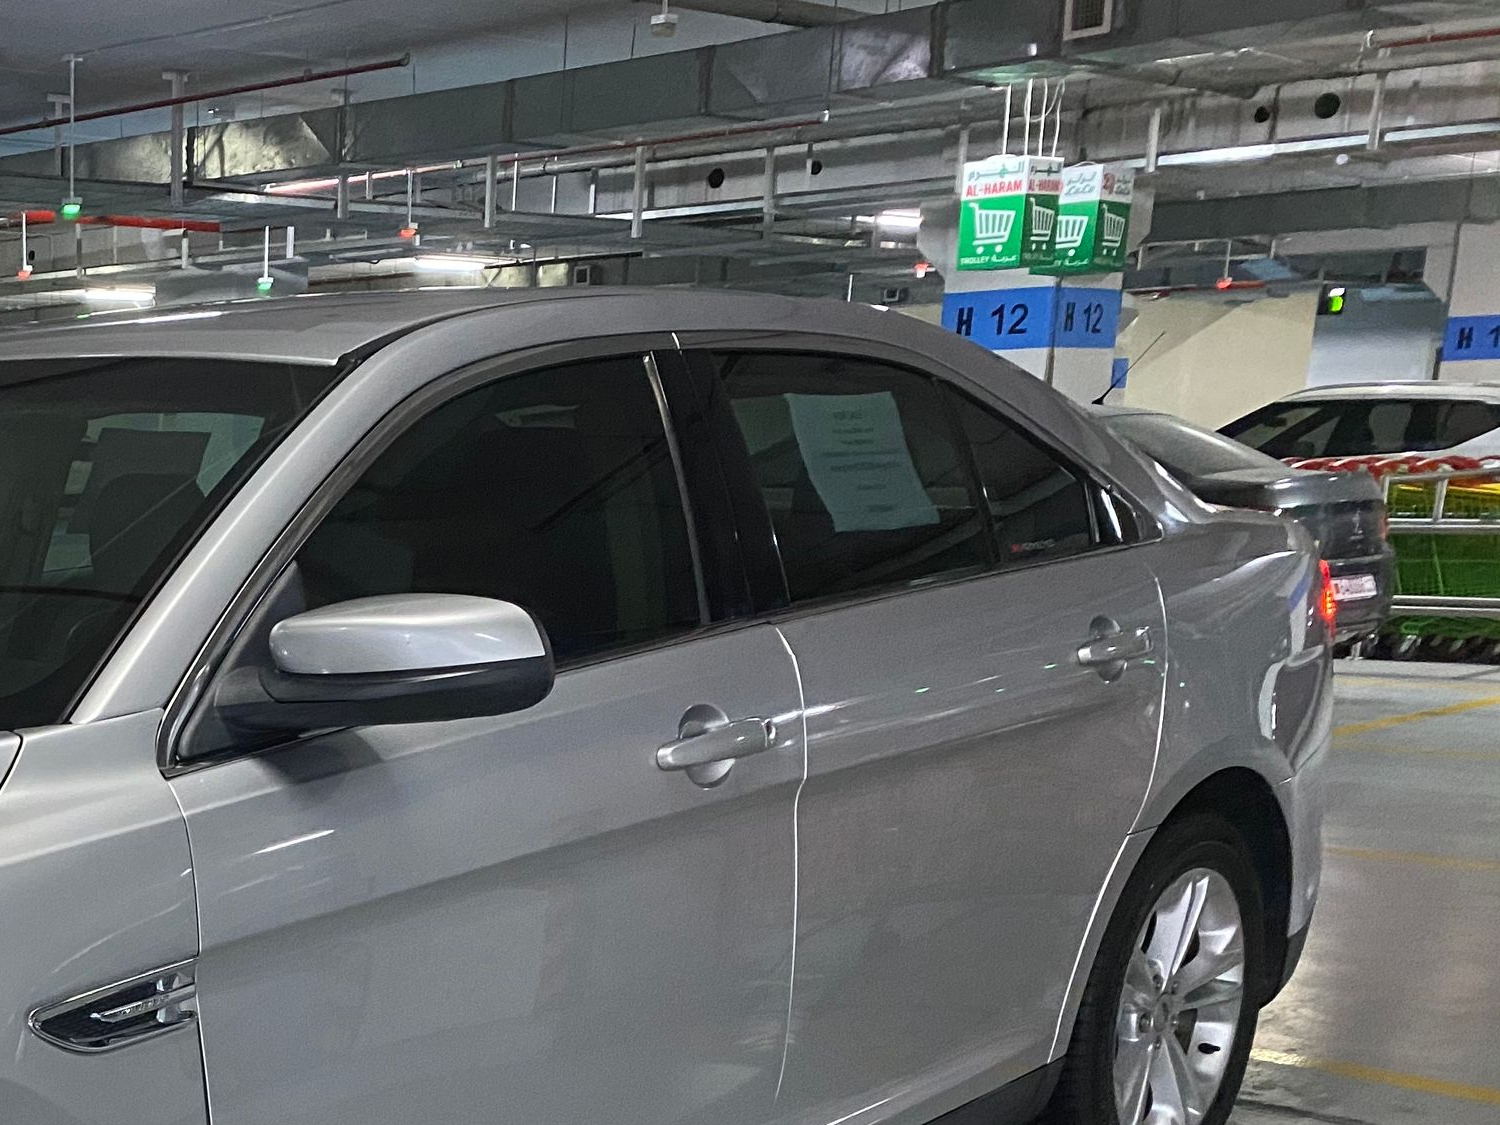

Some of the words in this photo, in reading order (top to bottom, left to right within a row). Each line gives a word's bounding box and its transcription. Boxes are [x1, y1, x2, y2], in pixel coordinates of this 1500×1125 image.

[966, 179, 1023, 198] AL-HARAM
[956, 306, 974, 336] H
[991, 303, 1029, 335] 12
[1063, 302, 1076, 332] H
[1083, 303, 1104, 333] 12
[1457, 326, 1474, 350] H
